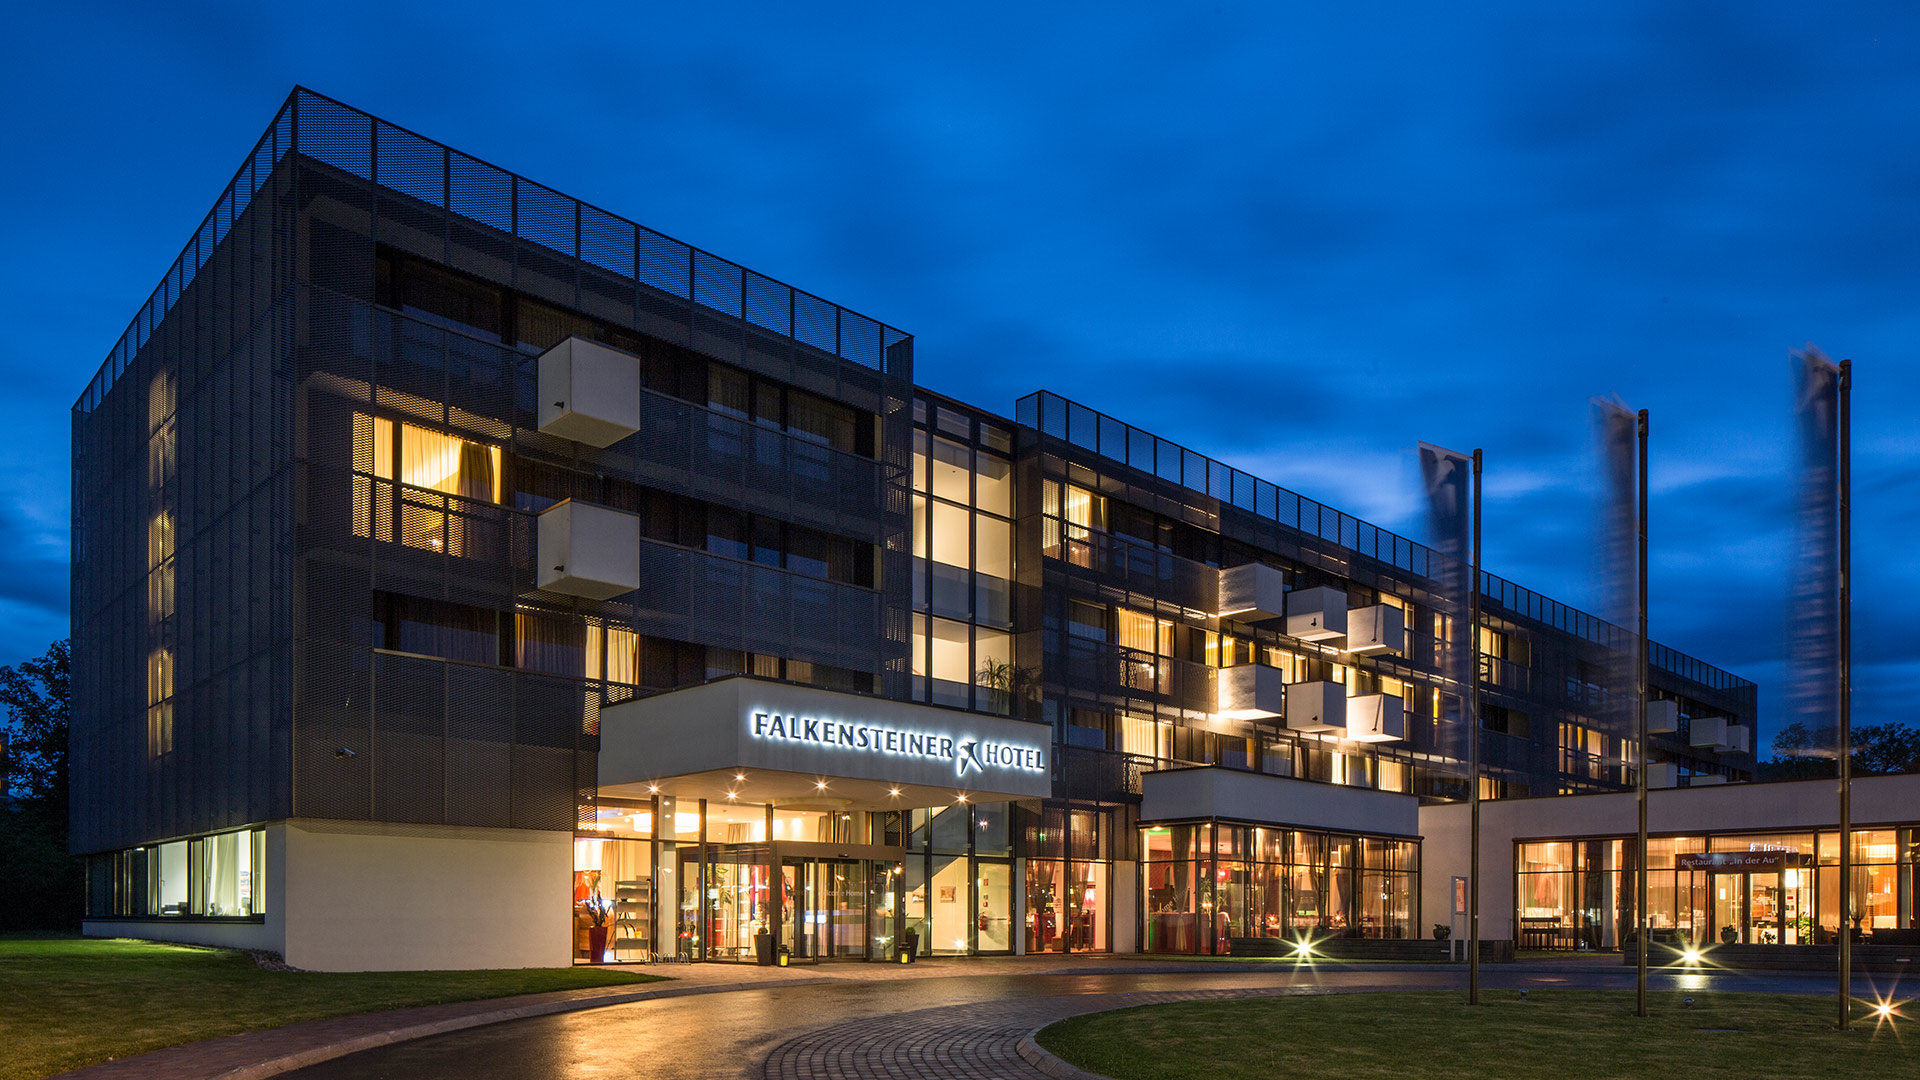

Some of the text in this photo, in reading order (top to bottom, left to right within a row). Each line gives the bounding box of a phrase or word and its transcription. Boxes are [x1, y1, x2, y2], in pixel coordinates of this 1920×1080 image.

[753, 712, 1045, 771] FALKENSTEINER HOTEL
[1745, 856, 1760, 865] der
